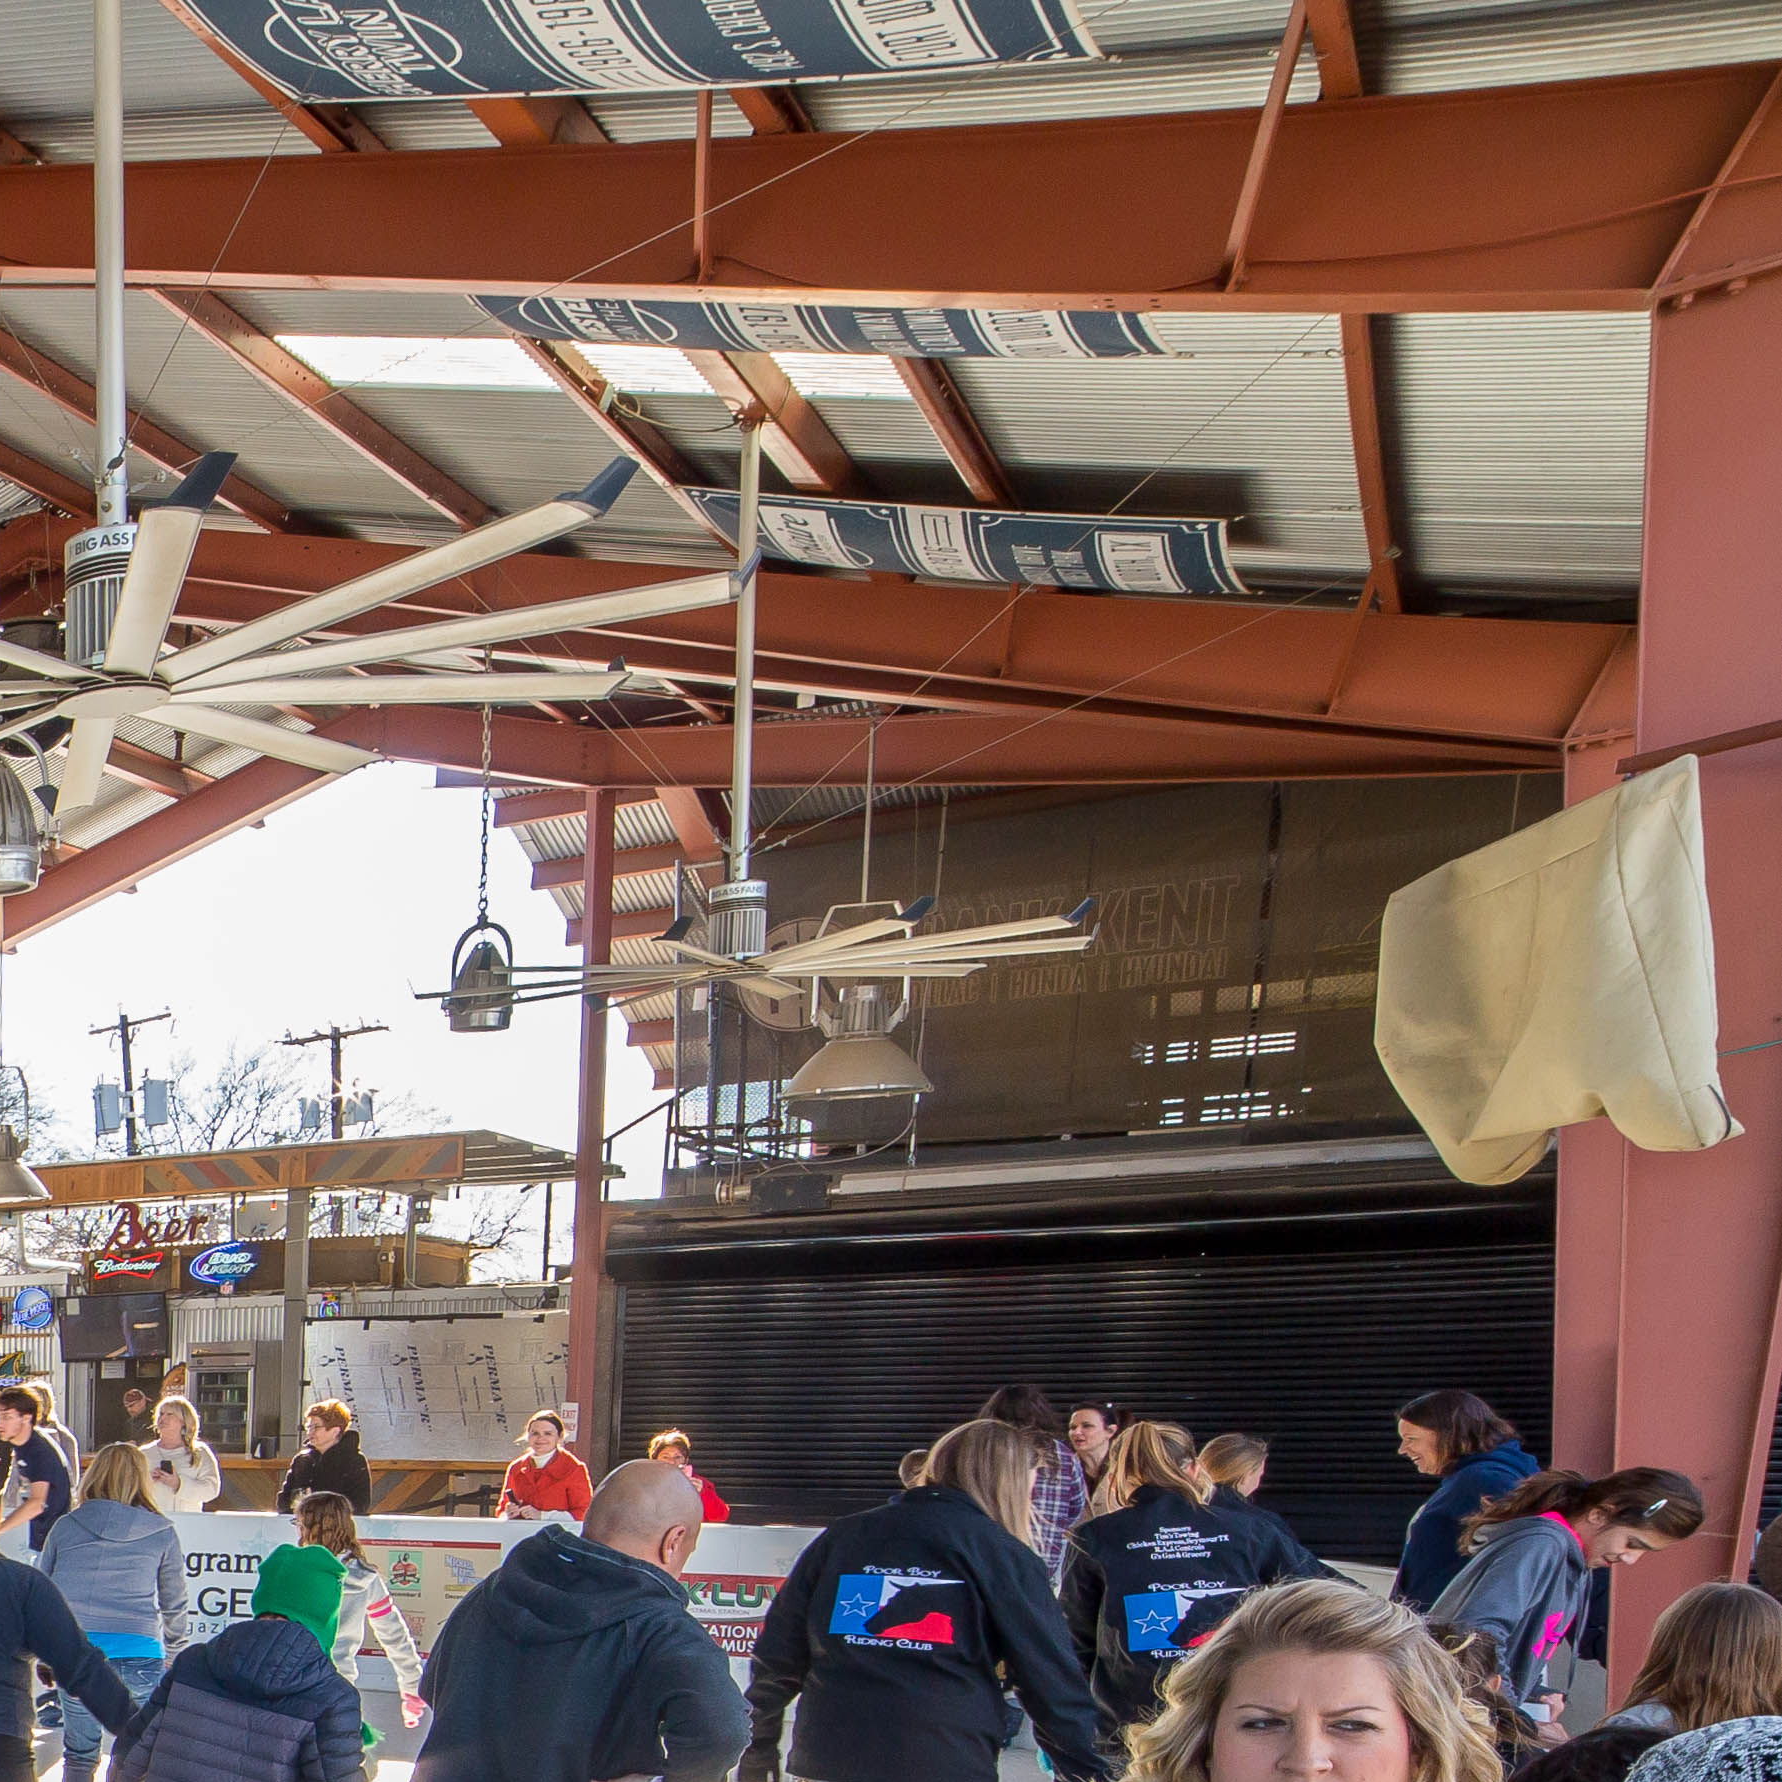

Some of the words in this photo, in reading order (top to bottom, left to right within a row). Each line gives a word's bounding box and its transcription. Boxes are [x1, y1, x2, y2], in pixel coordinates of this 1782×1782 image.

[340, 8, 435, 74] TWIN
[537, 0, 638, 73] 1966-19
[877, 22, 963, 63] FORT
[75, 538, 97, 555] BIG
[100, 532, 129, 549] ASS
[1083, 875, 1239, 958] KENT
[103, 1202, 209, 1250] Beer
[94, 1259, 160, 1273] Budweiser
[201, 1263, 258, 1275] LIGHT
[209, 1253, 253, 1265] BUD
[407, 1344, 427, 1404] PERMA
[483, 1344, 502, 1403] PERMA
[863, 1565, 904, 1577] POOR
[907, 1566, 942, 1578] BOY
[1148, 1582, 1191, 1592] POOR
[1193, 1580, 1225, 1588] BOY
[844, 1634, 893, 1649] RIDING
[895, 1638, 933, 1651] CLUB
